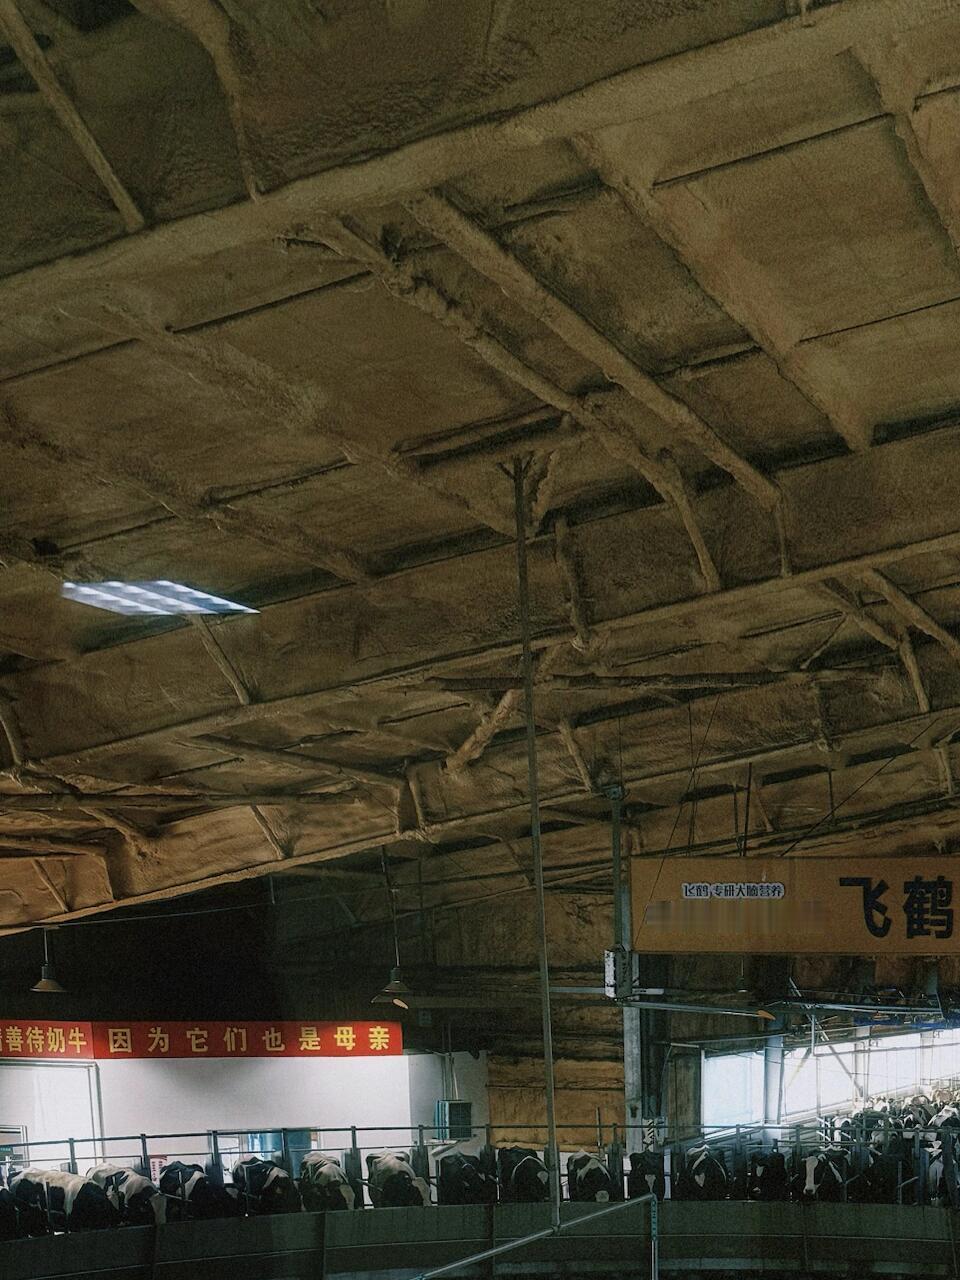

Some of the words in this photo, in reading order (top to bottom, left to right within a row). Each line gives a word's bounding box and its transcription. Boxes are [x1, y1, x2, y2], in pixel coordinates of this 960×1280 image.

[0, 1026, 87, 1053] 善待奶牛
[108, 1026, 390, 1053] 因为它们也是母亲
